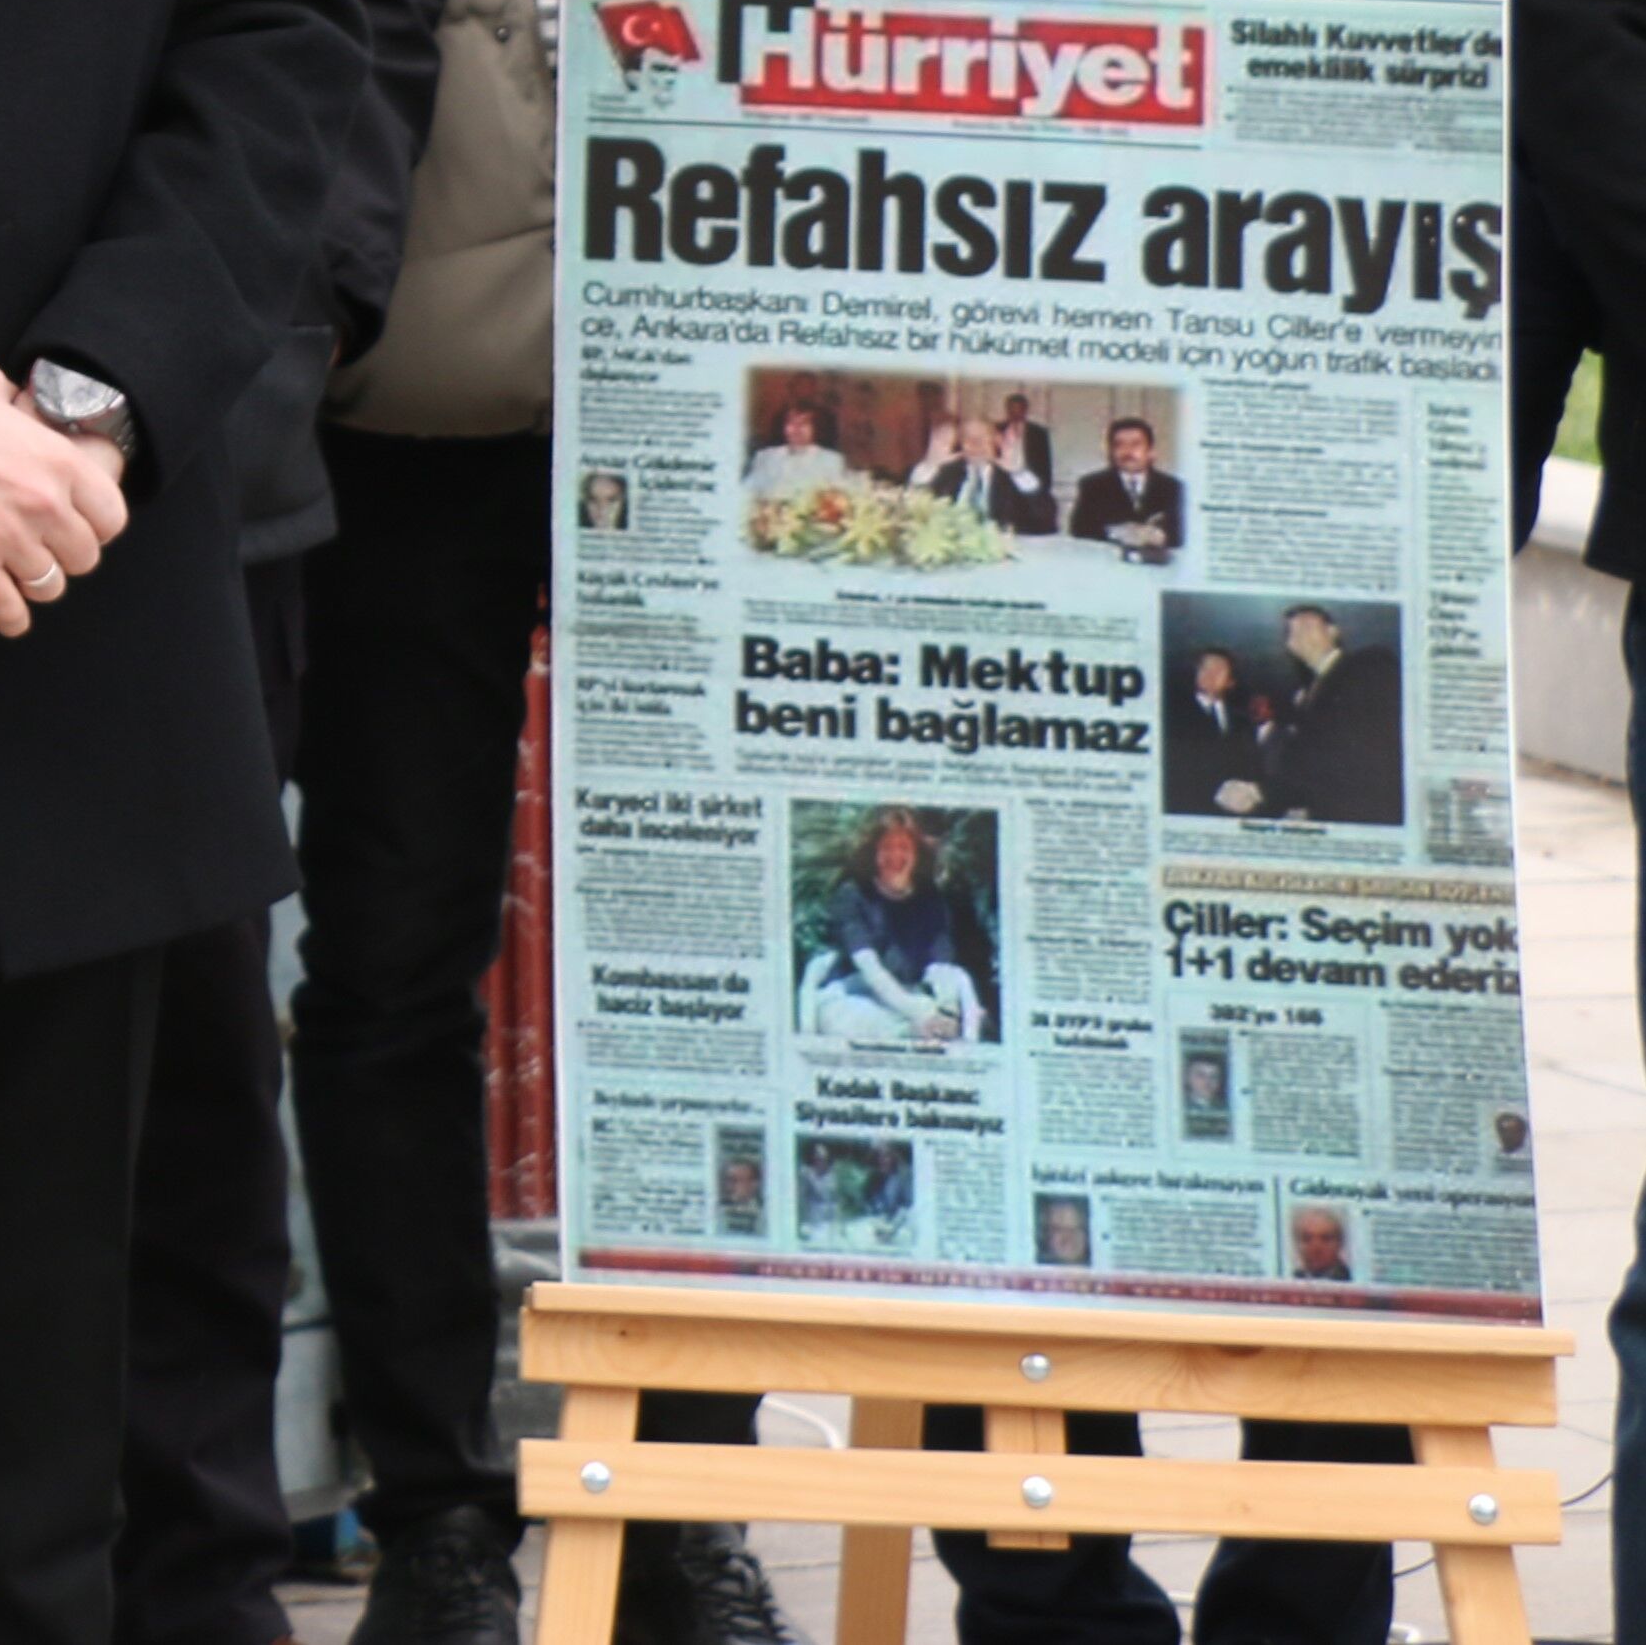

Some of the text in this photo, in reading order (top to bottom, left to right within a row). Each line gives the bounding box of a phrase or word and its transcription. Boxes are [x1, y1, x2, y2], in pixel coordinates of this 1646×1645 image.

[740, 4, 1194, 118] Hürriyet
[584, 136, 1502, 320] Refahsız arayış
[581, 279, 808, 316] Cumhurbaşkanı
[950, 299, 1039, 328] görevi
[1052, 304, 1153, 331] hemen
[1166, 307, 1254, 338] Tansu
[629, 316, 769, 344] Ankara'da
[908, 326, 939, 352] bir
[741, 633, 901, 686] Baba:
[918, 642, 1146, 706] Mektup
[734, 690, 1151, 755] beni bağlamaz
[1163, 898, 1288, 948] Çiller:
[1300, 905, 1433, 954] Seçim
[1165, 942, 1235, 982] 1+1
[1245, 947, 1387, 988] devam
